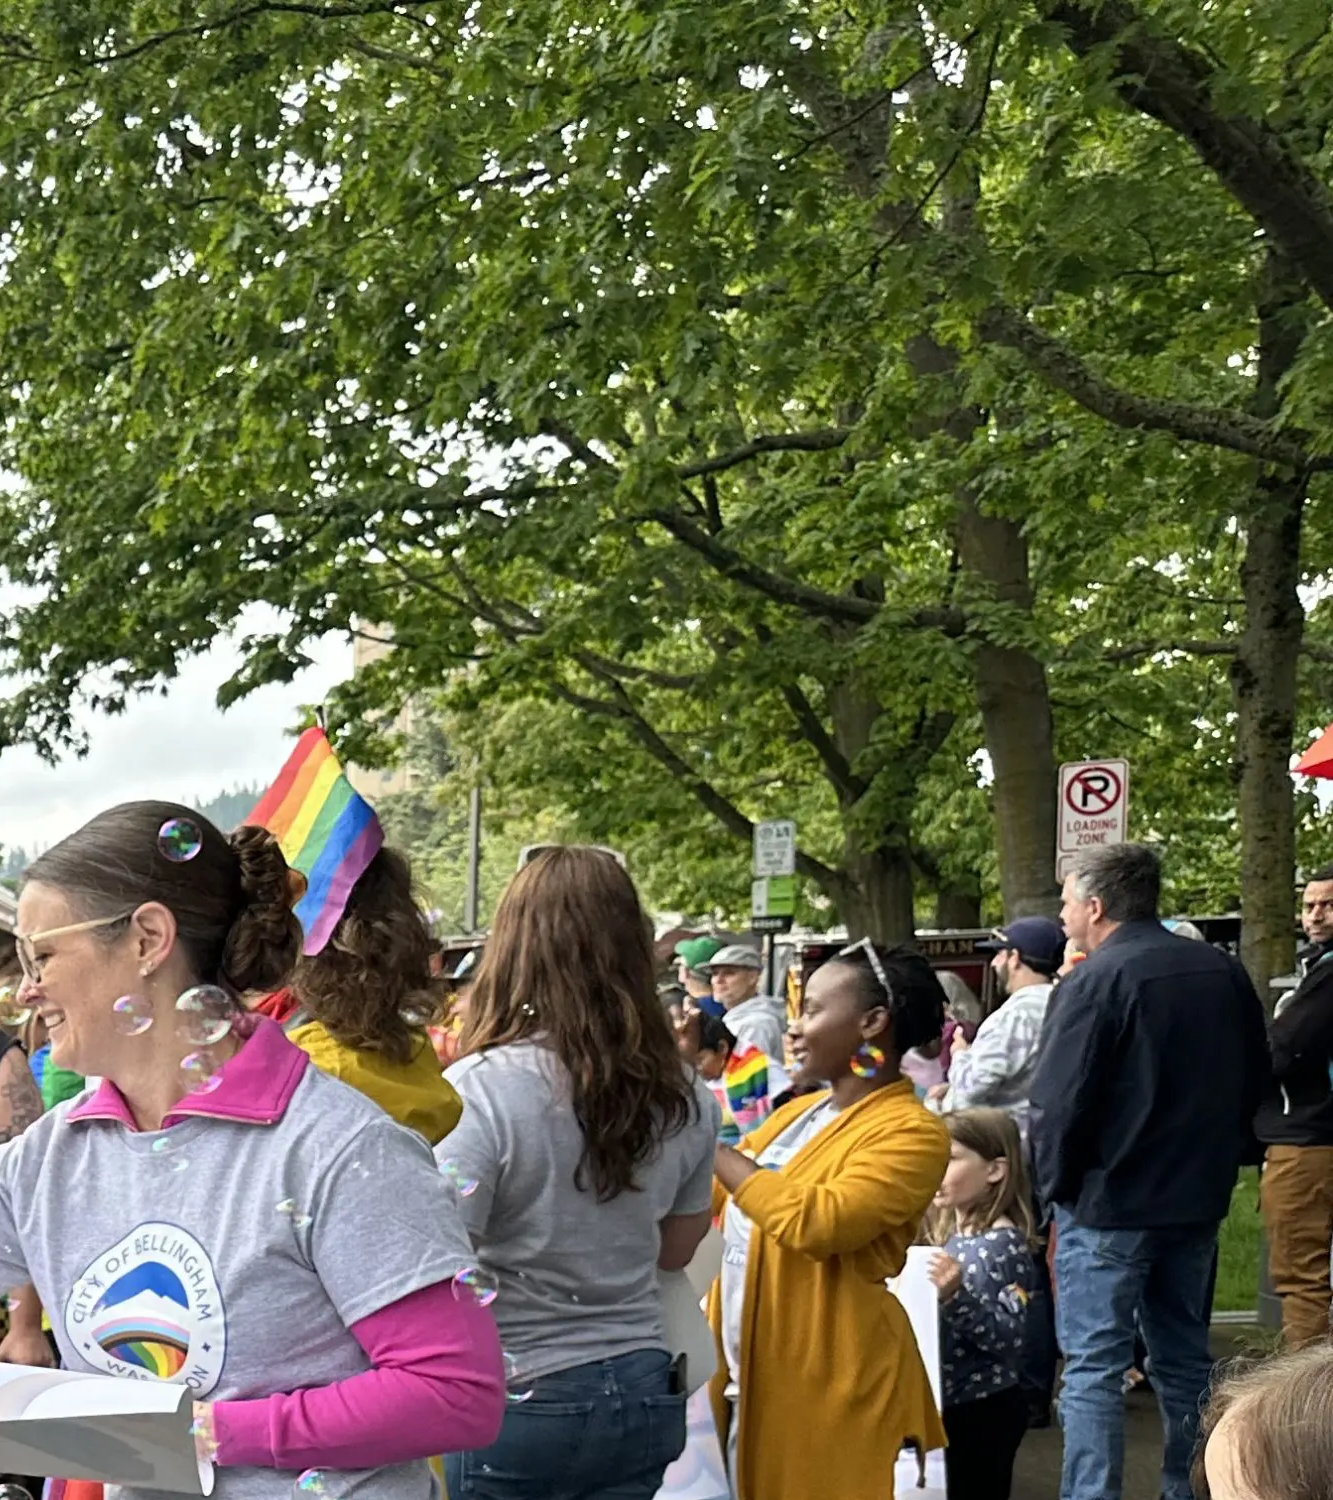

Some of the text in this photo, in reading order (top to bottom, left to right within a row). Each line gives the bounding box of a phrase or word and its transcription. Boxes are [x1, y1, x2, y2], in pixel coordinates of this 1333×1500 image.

[1065, 818, 1118, 833] LOADING
[1075, 832, 1109, 846] ZONE
[73, 1234, 213, 1324] CITY OF BELLINGHAM
